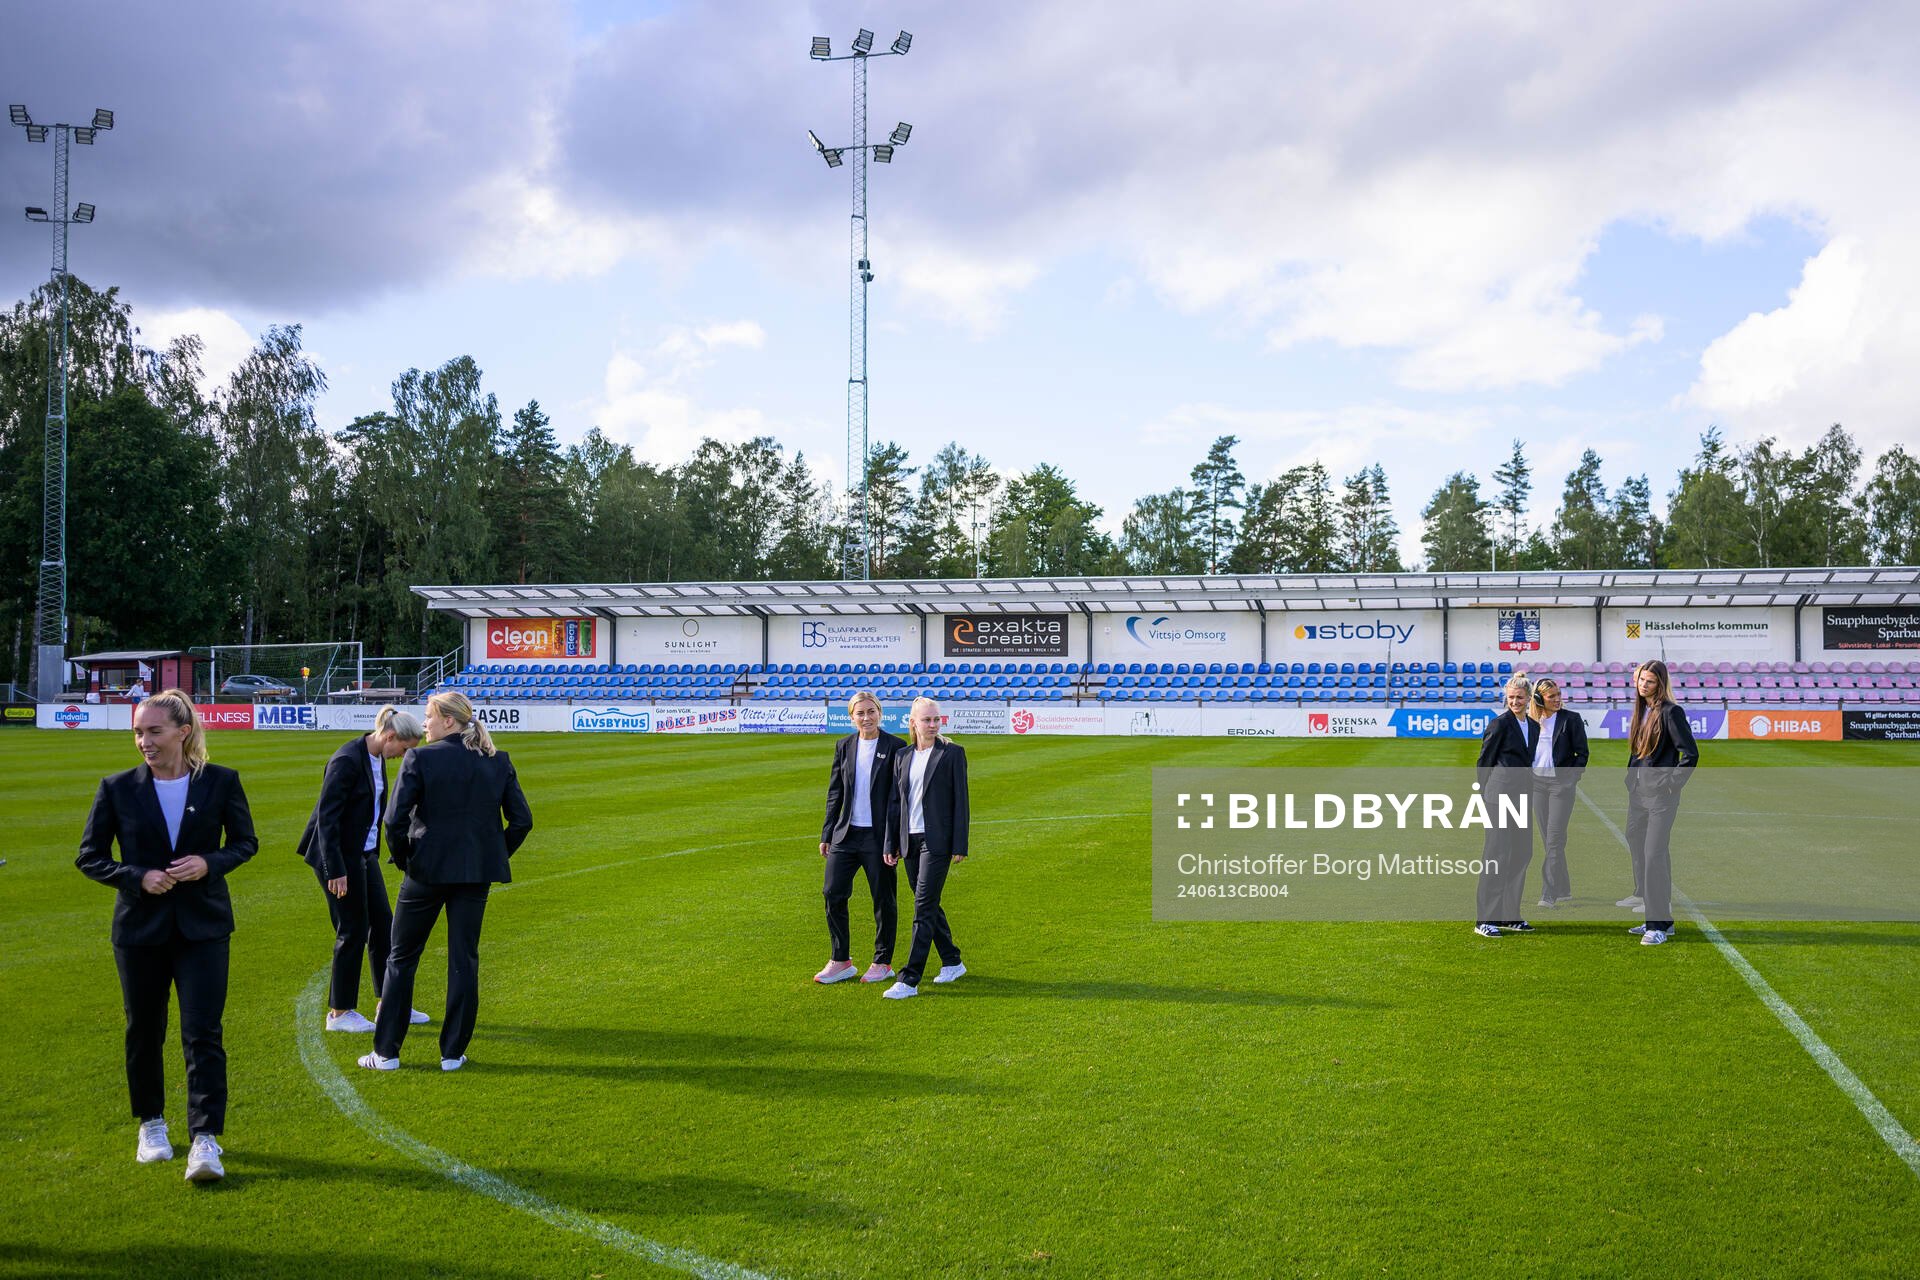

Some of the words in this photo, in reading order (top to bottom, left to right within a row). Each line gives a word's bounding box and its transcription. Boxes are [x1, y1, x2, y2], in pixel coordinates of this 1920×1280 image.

[977, 618, 1061, 632] exakta
[1645, 621, 1716, 631] Hässleholms
[1718, 621, 1769, 630] kommun
[1827, 614, 1920, 628] Snapphanebygde
[491, 626, 548, 645] clean
[1184, 629, 1226, 641] Omsorg
[1319, 619, 1415, 644] stoby
[977, 632, 1061, 645] creative
[56, 713, 88, 721] Lindvalls
[197, 712, 251, 723] ELLNESS
[258, 706, 313, 725] MBE
[576, 715, 646, 728] ÄLVSBYHUS
[655, 714, 696, 732] RÖKE
[699, 708, 737, 725] BUSS
[740, 707, 778, 723] Vittsjö
[778, 707, 825, 723] Camping
[1332, 717, 1378, 725] SVENSKA
[1332, 726, 1356, 734] SPEL
[1407, 714, 1449, 734] Heja
[1452, 714, 1489, 735] dig!
[1774, 720, 1821, 733] HIBAB
